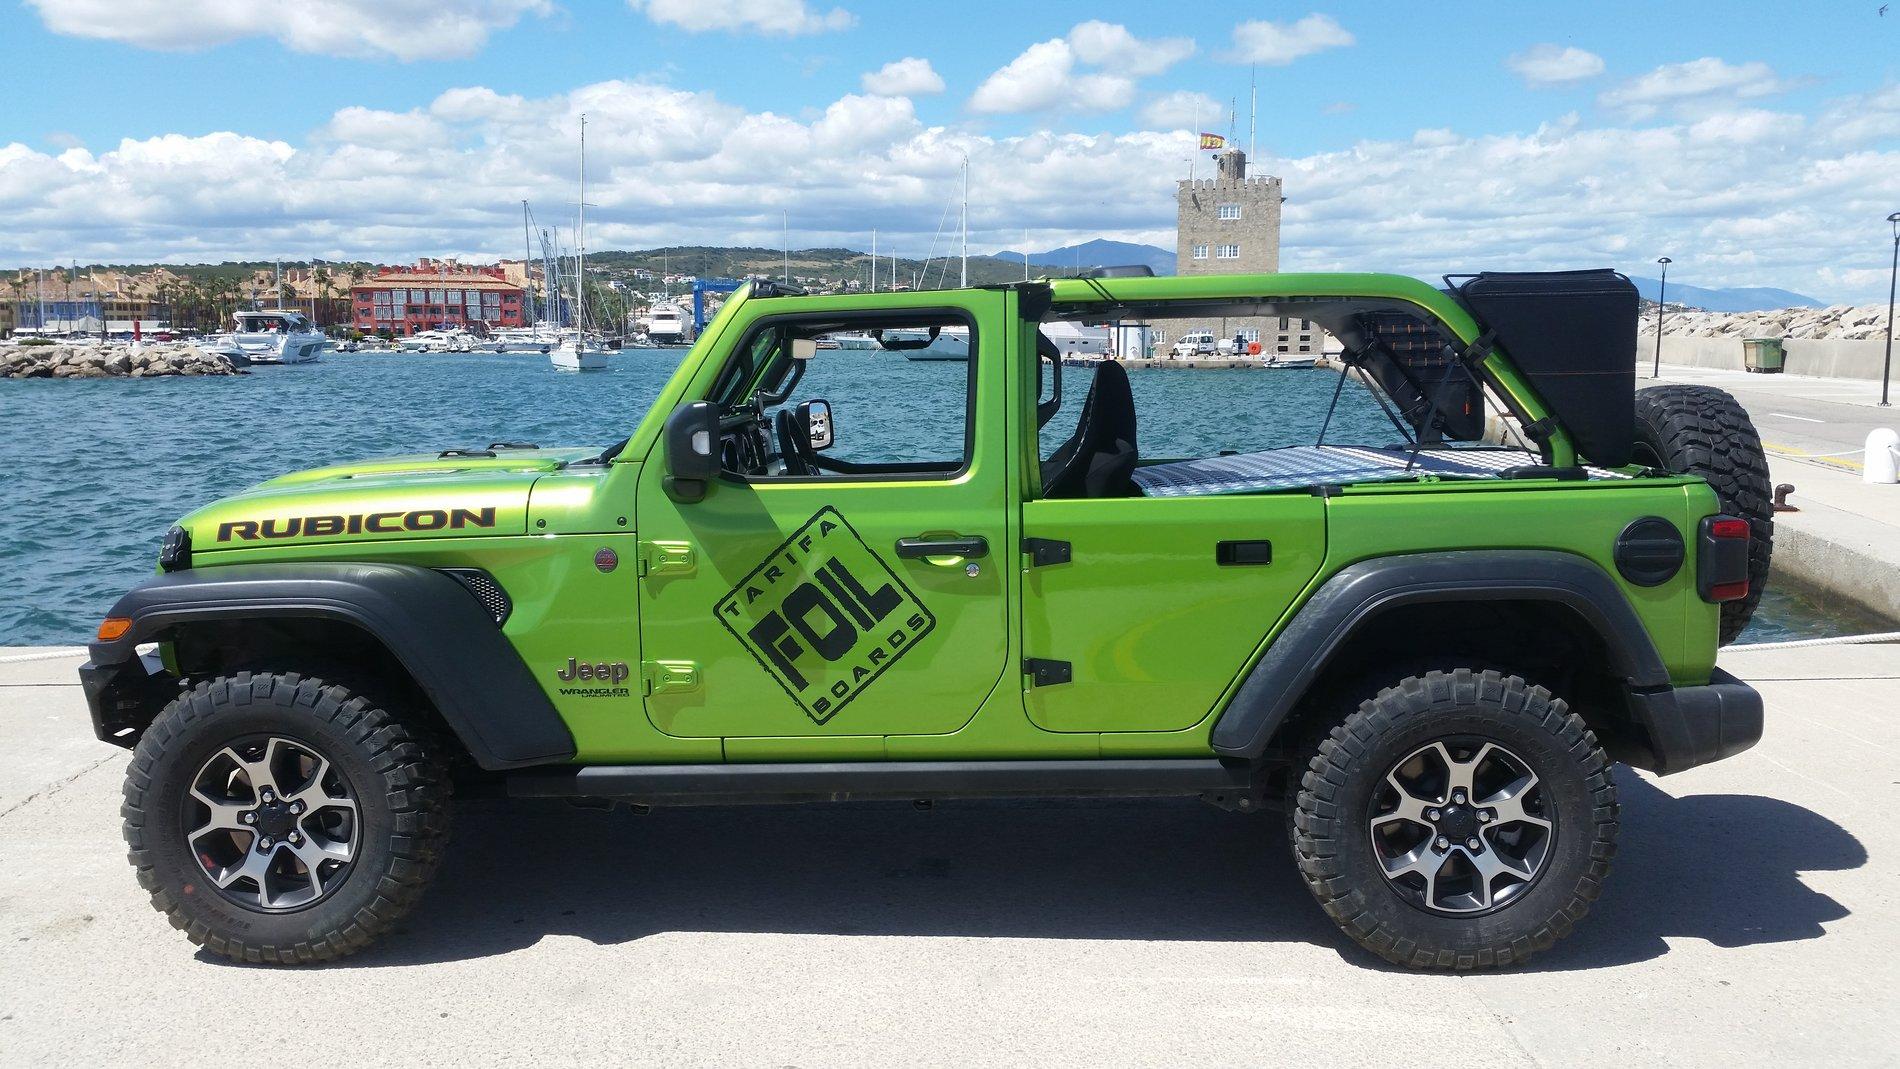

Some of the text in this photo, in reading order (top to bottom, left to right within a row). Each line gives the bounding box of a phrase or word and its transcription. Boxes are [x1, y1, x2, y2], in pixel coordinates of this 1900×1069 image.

[216, 506, 496, 542] RUBICON
[724, 520, 837, 616] TARIFA
[557, 656, 629, 684] Jeep
[747, 556, 904, 693] FOIL
[812, 613, 925, 715] BOARDS
